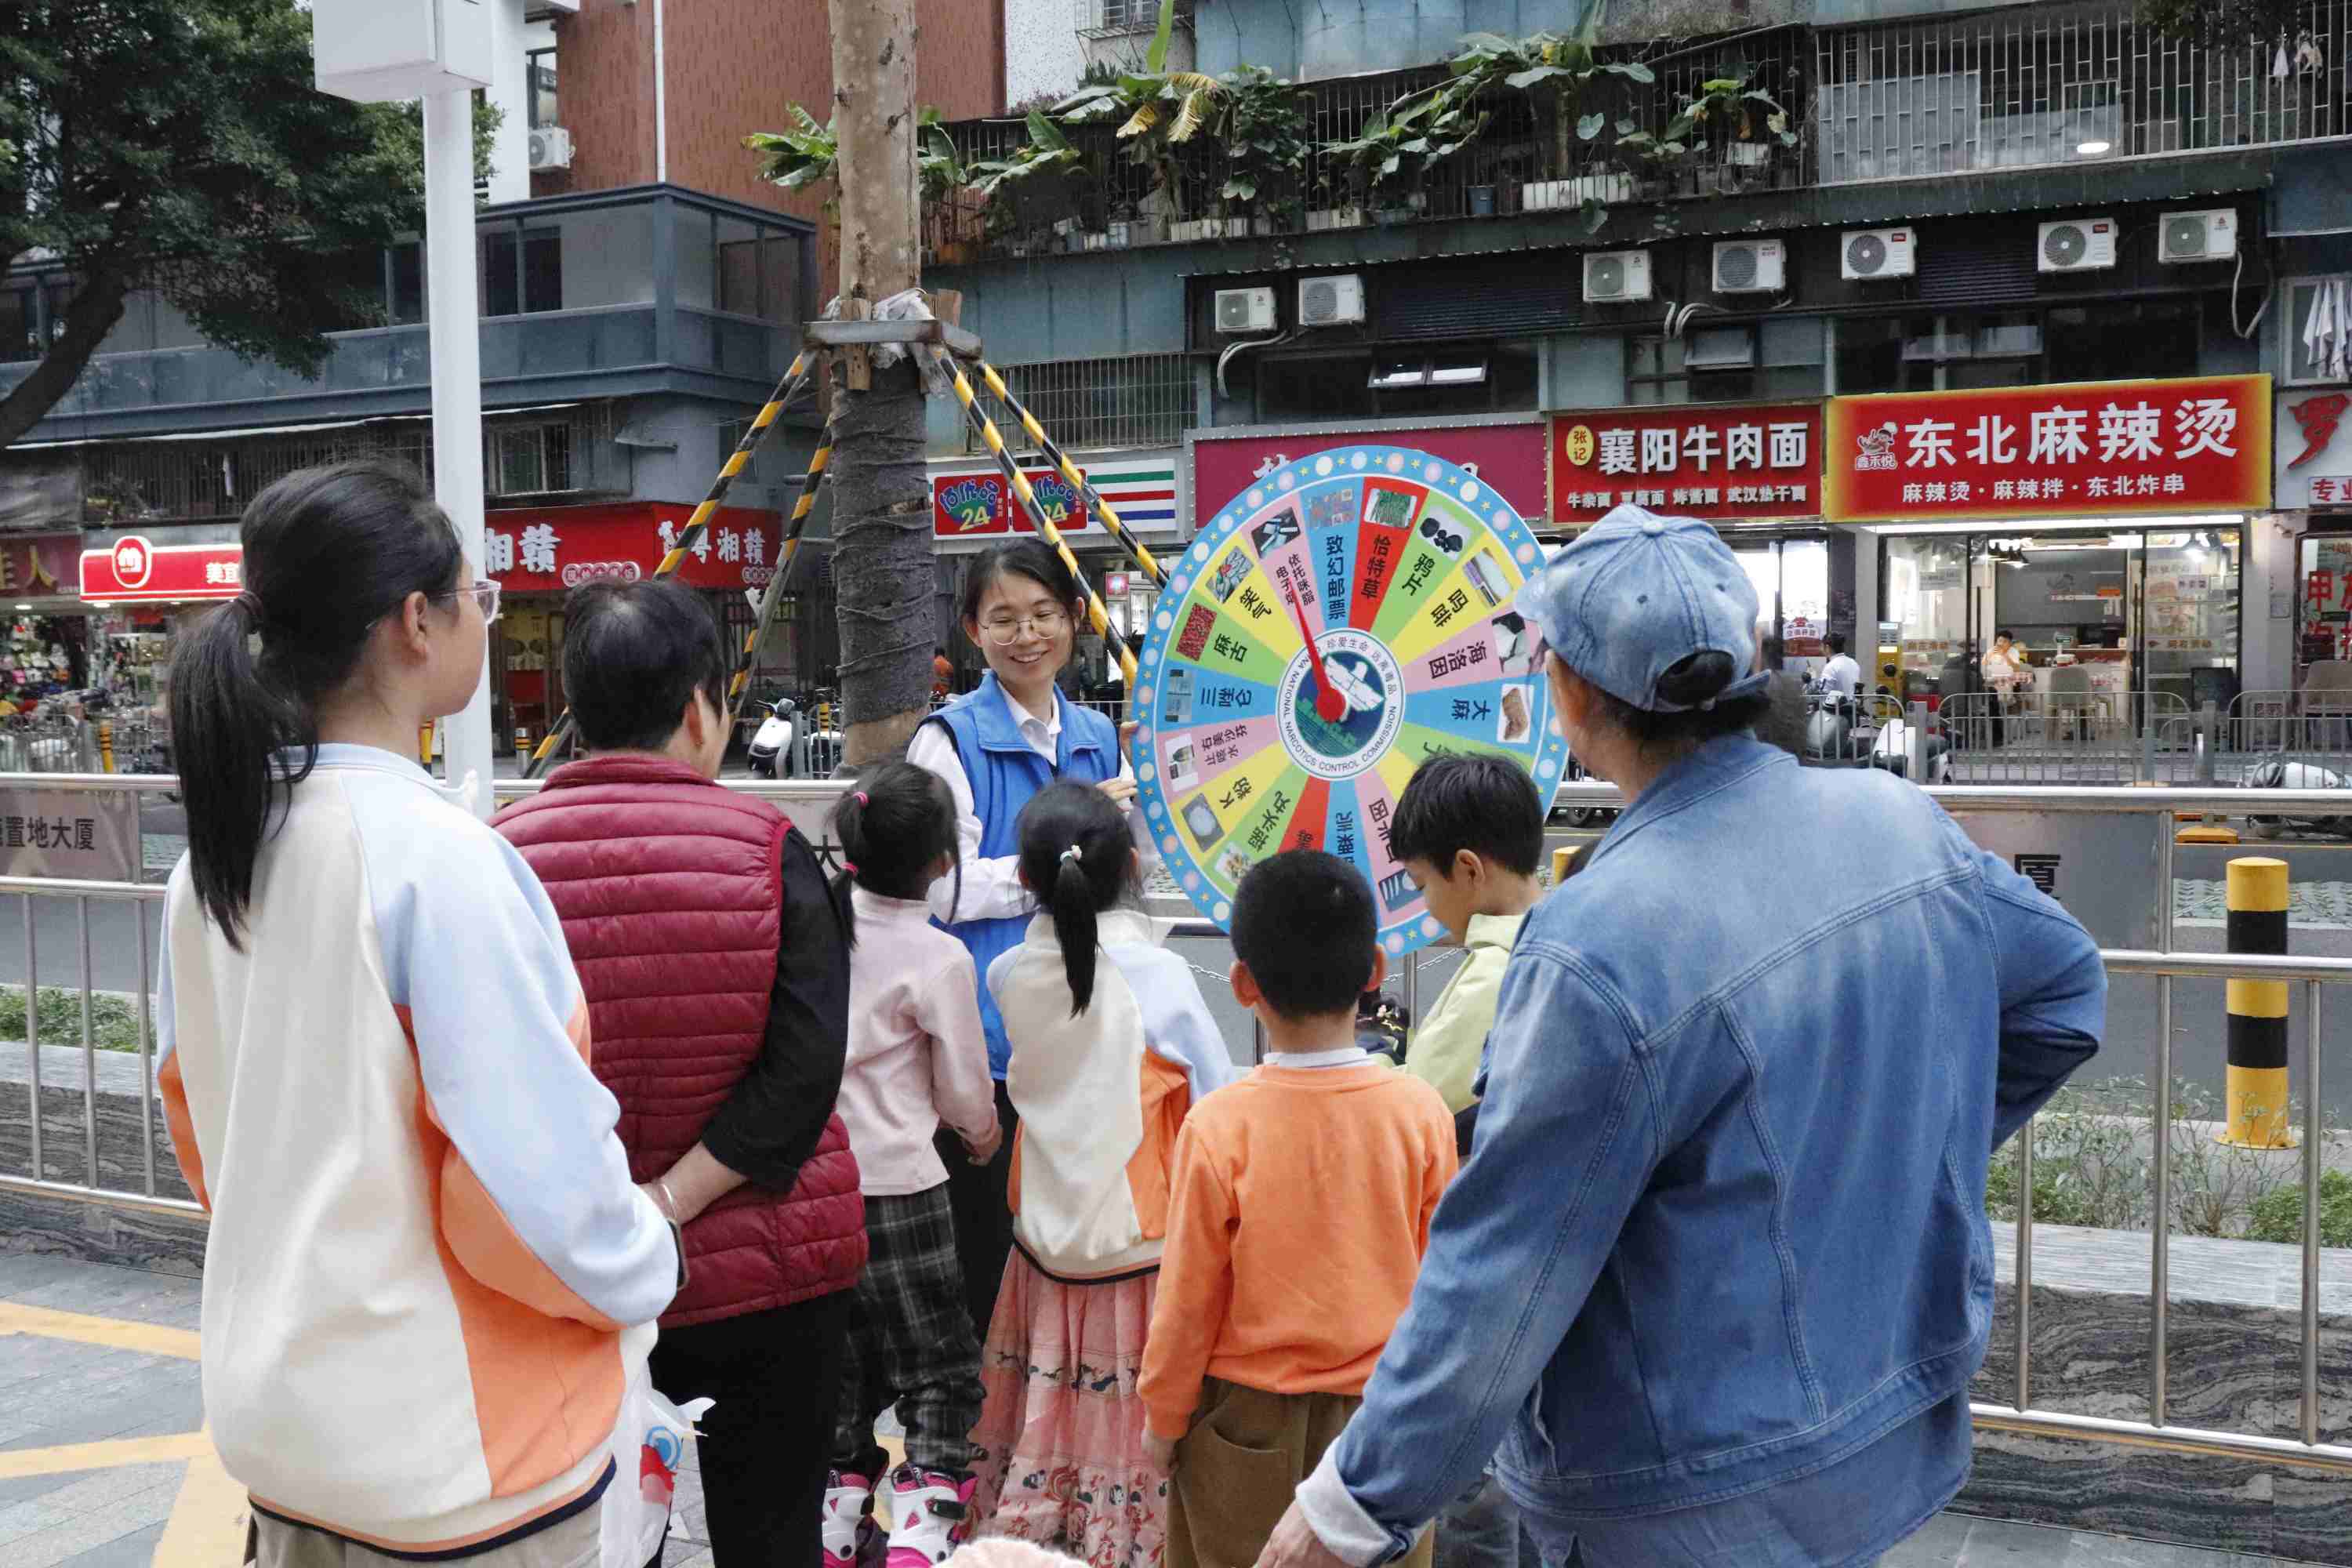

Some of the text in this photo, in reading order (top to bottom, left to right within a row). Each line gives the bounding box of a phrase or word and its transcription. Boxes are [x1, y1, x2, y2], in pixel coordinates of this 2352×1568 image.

[1573, 430, 1588, 461] 张记
[1599, 423, 1809, 475] 襄阳牛肉面
[1904, 398, 2238, 468] 东北麻辣烫
[959, 506, 992, 532] 24
[1326, 534, 1346, 620] 致幻邮票
[1360, 534, 1392, 600] 恰特草
[1402, 553, 1436, 597] 鸦片
[1240, 586, 1272, 619] 笑气
[1430, 588, 1469, 628] 吗啡
[1213, 633, 1248, 662] 麻古
[1428, 640, 1487, 680] 海洛因
[1200, 686, 1253, 708] 三唑仑
[1283, 670, 1301, 717] NATIONAL
[1451, 699, 1491, 721] 大麻
[1202, 724, 1248, 752] 右美沙芬
[1284, 720, 1318, 767] NARCOTICS
[1361, 705, 1397, 763] COMMISSION
[1204, 744, 1239, 766] 止咳水
[1318, 759, 1360, 772] CONTROL
[1219, 776, 1253, 810] K粉
[0, 816, 96, 851] 置地大厦
[1247, 789, 1292, 854] 摇头丸
